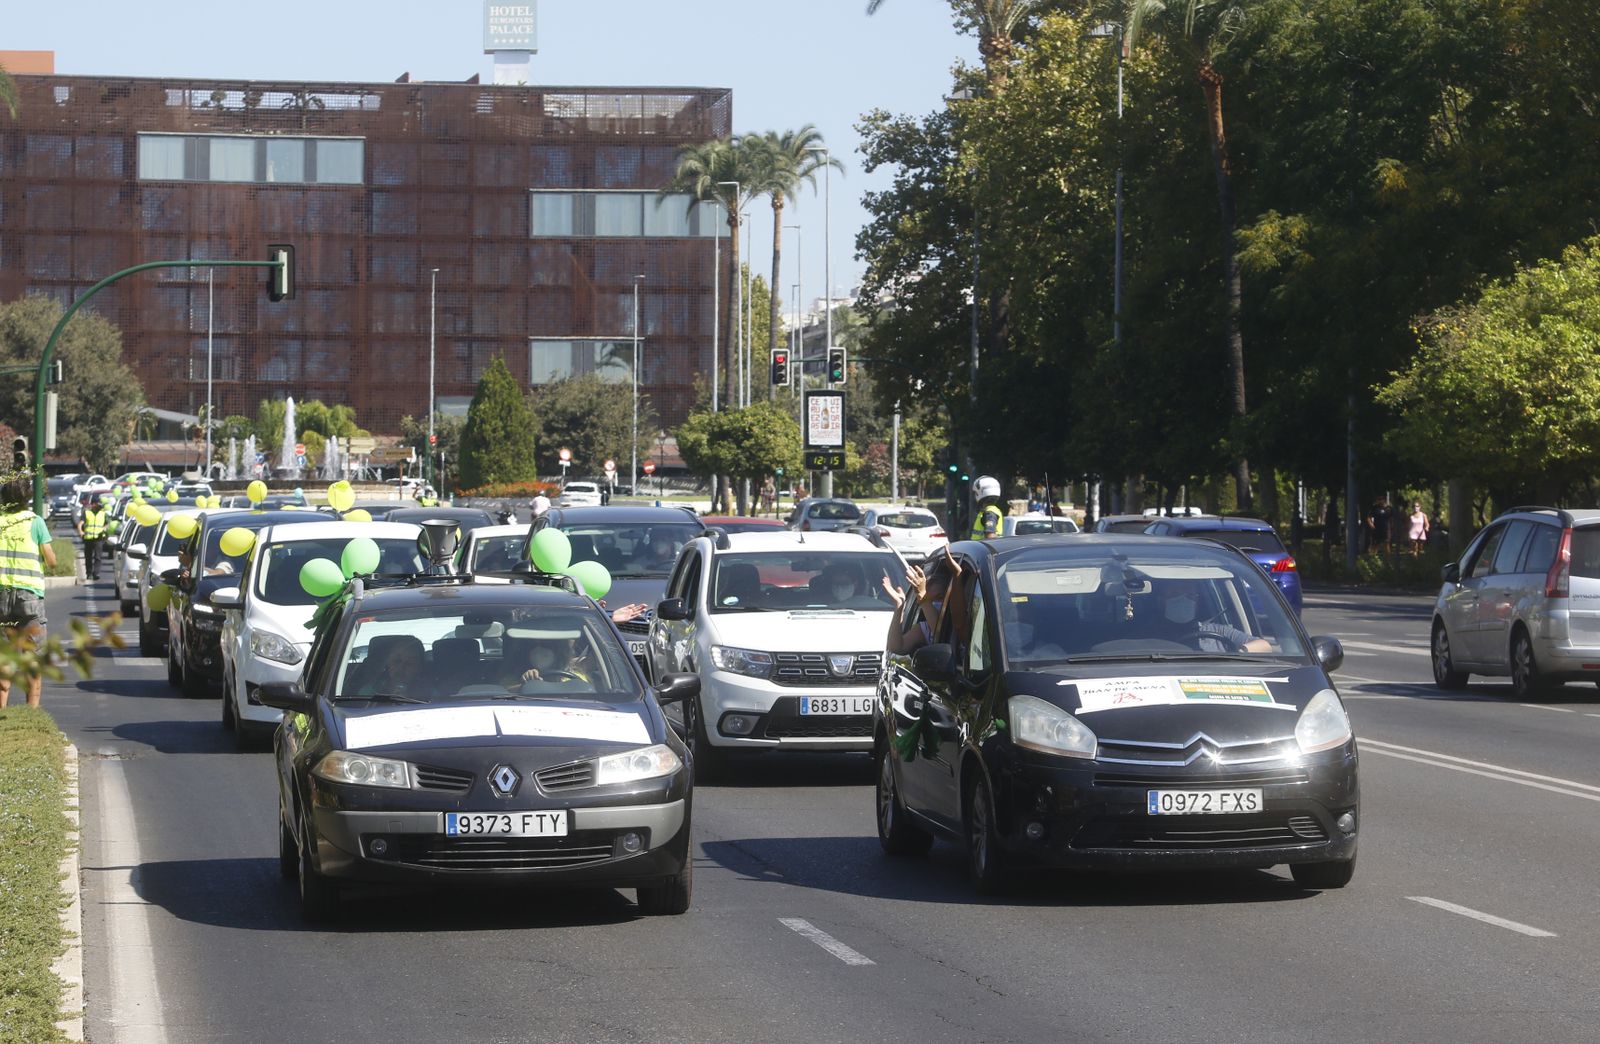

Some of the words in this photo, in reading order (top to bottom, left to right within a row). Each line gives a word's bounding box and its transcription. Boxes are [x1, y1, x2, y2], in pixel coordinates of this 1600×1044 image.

[489, 6, 534, 16] HOTEL
[489, 25, 534, 34] PALACE
[813, 456, 840, 465] 12:15
[811, 699, 846, 712] 6831
[1162, 793, 1212, 812] 0972
[1220, 792, 1257, 811] FXS
[459, 815, 512, 834] 9373
[521, 813, 560, 833] FTY
